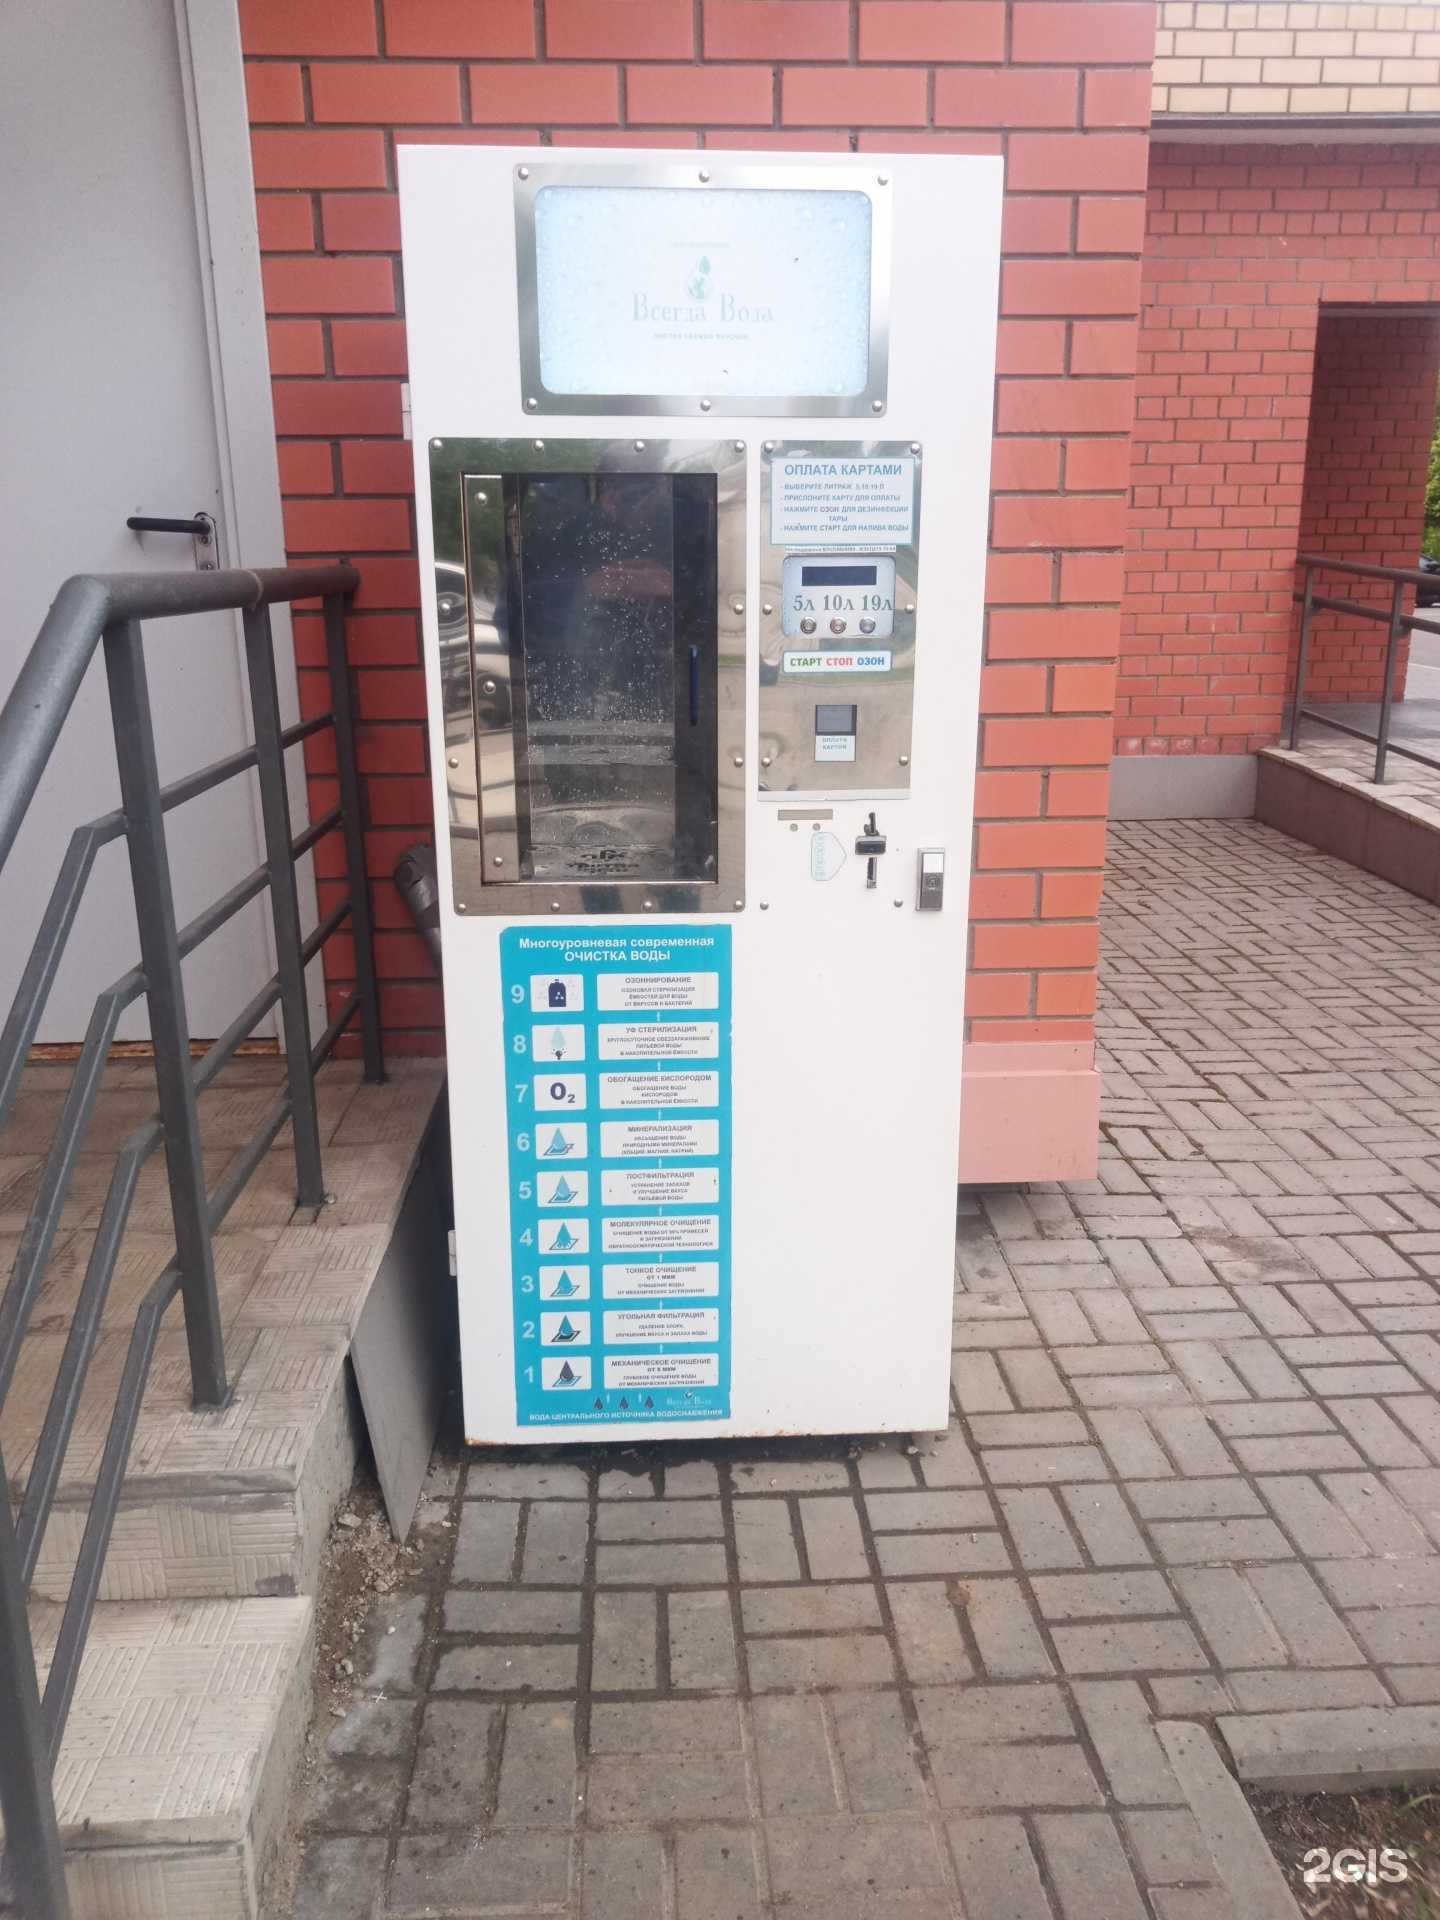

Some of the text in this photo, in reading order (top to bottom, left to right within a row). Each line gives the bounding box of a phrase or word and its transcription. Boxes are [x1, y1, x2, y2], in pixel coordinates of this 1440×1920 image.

[631, 292, 708, 322] Всегда
[784, 464, 902, 476] ОПЛАТА КАРТАМИ
[823, 594, 855, 611] 10л
[862, 594, 893, 611] 19л
[790, 656, 885, 667] СТАРТ СТОП ОЗОН
[519, 937, 715, 950] Многоуровневая современная
[564, 950, 671, 962] ОЧИСТКА ВОДЫ
[511, 984, 525, 1004] 9
[513, 1034, 527, 1054] 8
[515, 1084, 528, 1103] 7
[628, 1125, 693, 1133] МИНЕРАЛИЗАЦИЯ
[516, 1133, 531, 1151] 6
[626, 1172, 695, 1180] ПОСТФИЛЬТРАЦИЯ
[519, 1181, 532, 1199] 5
[610, 1219, 711, 1228] МОЛЕКУЛЯРНОЕ ОЧИЩЕНИЕ
[519, 1228, 533, 1246] 4
[656, 1266, 697, 1274] ОЧИЩЕНИЕ
[521, 1275, 534, 1293] 3
[617, 1312, 705, 1320] УГОЛЬНАЯ ФИЛЬТРАЦИЯ
[522, 1321, 535, 1339] 2
[611, 1358, 711, 1367] МЕХАНИЧЕСКОЕ ОЧИЩЕНИЕ
[523, 1366, 534, 1383] 1
[529, 1413, 550, 1421] ВОДА
